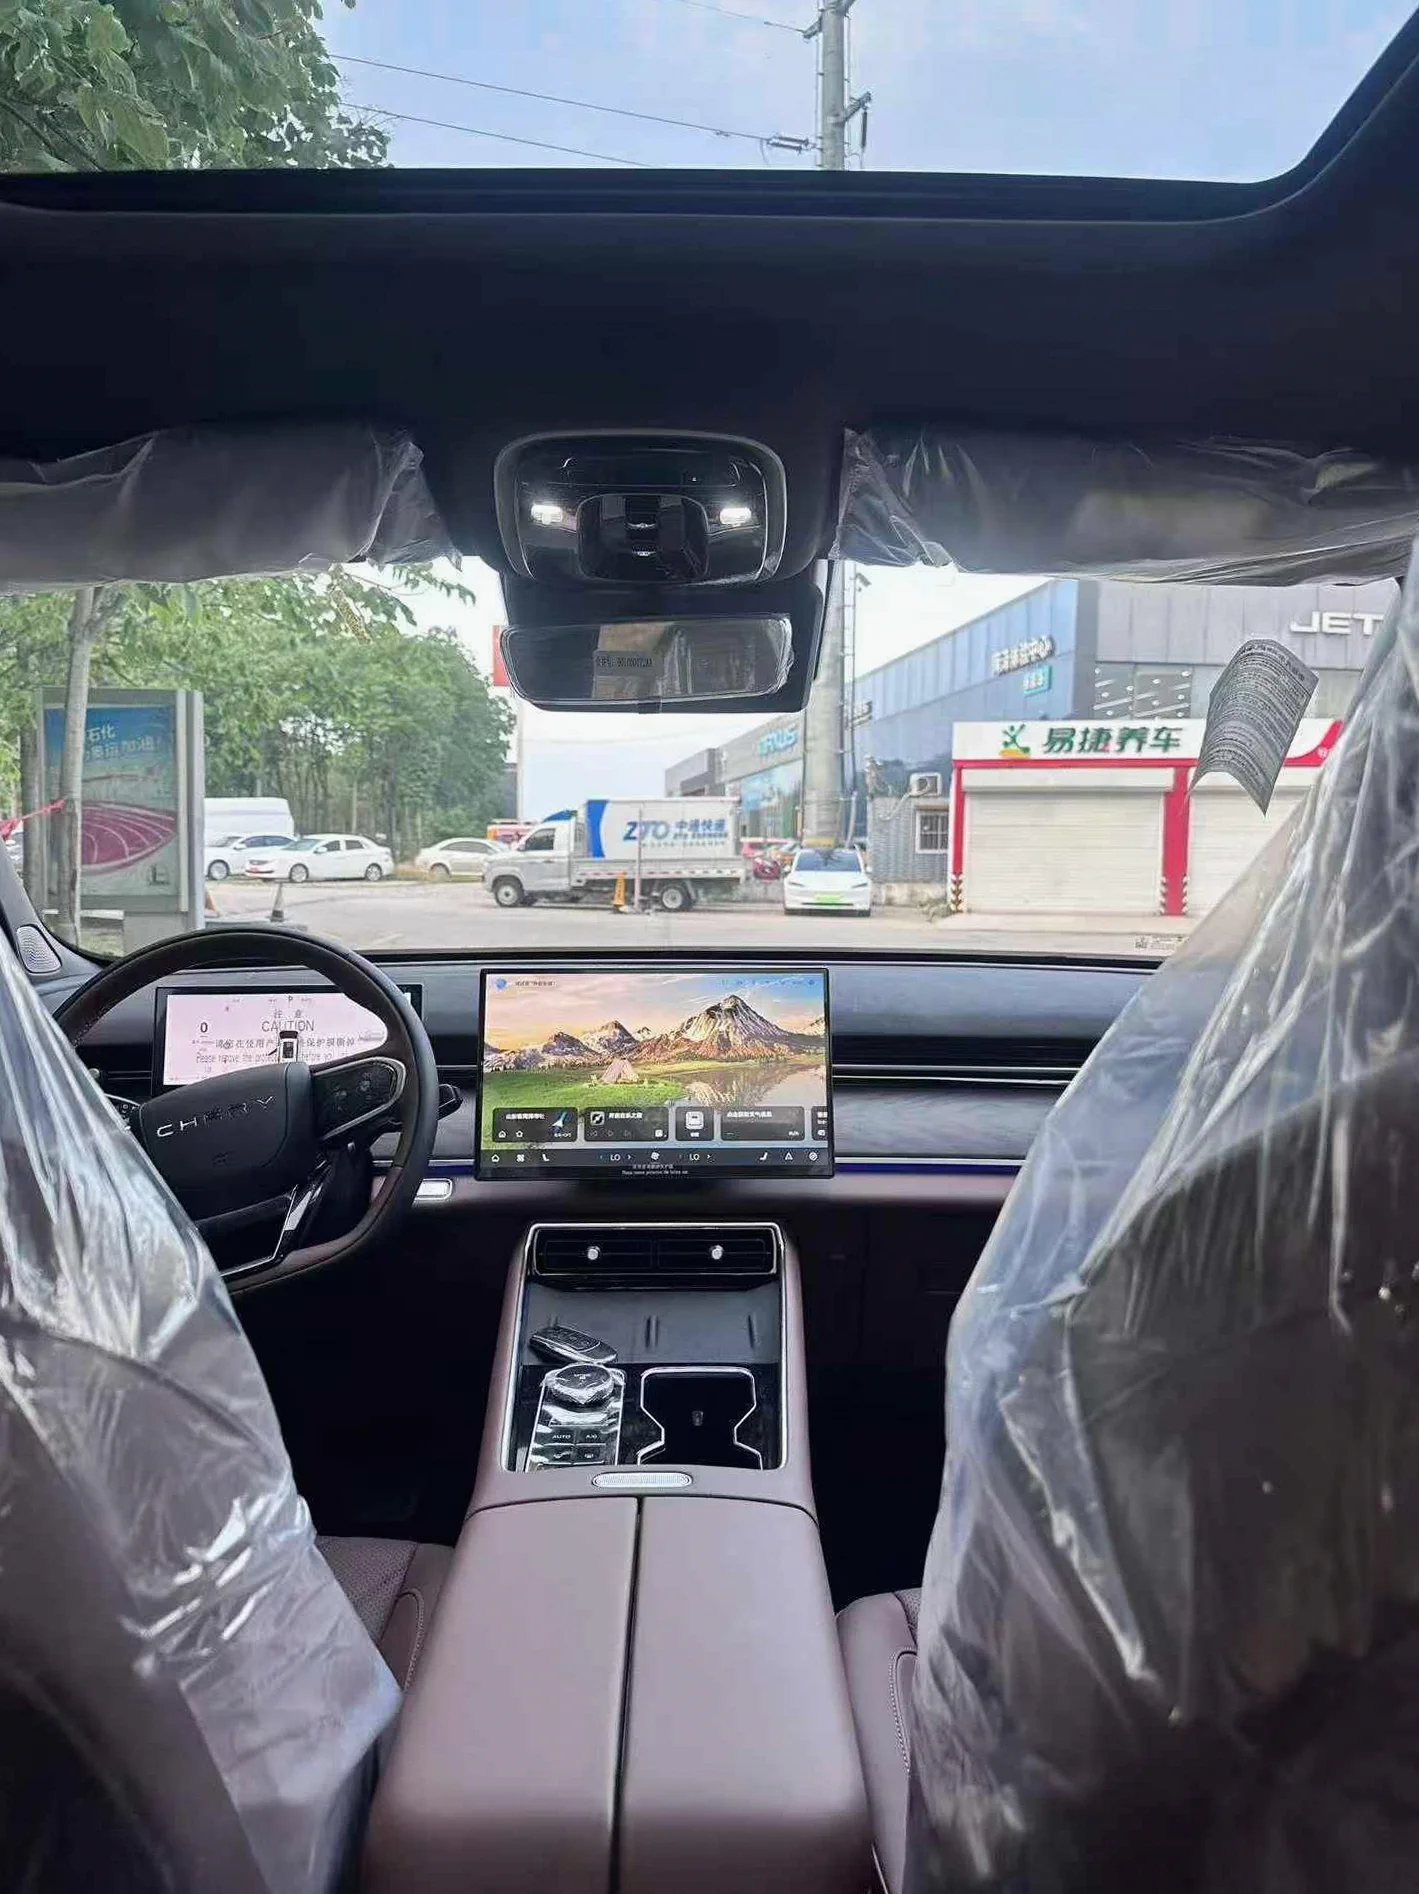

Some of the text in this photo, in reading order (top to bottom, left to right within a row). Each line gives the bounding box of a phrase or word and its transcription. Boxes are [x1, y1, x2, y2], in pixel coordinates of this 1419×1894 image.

[1042, 726, 1184, 754] 易捷养车
[622, 819, 670, 841] ZTO
[199, 1022, 208, 1033] 0
[261, 1020, 315, 1033] CAUTION
[156, 1095, 275, 1137] CHERY
